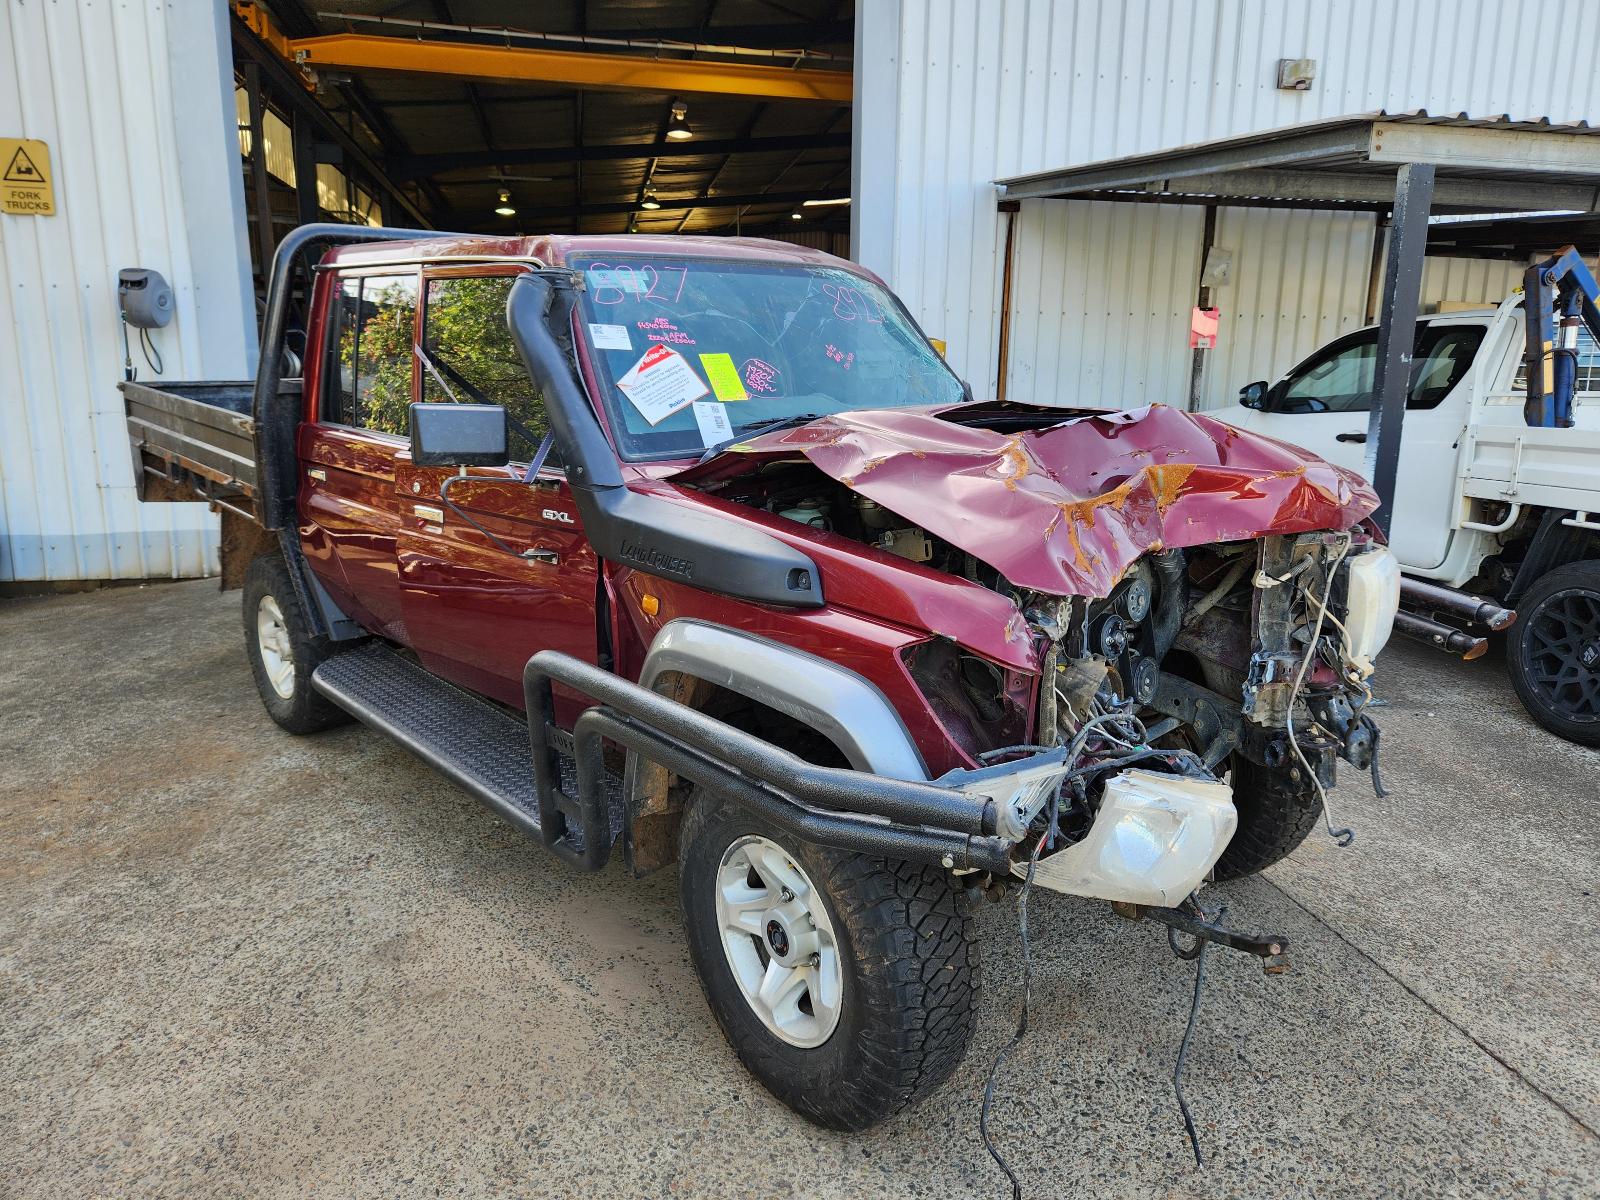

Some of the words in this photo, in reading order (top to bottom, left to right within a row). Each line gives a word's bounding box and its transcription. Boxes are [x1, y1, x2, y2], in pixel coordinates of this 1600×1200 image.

[11, 191, 41, 200] FORK
[5, 200, 50, 210] TRUCKS
[542, 508, 575, 524] GXL
